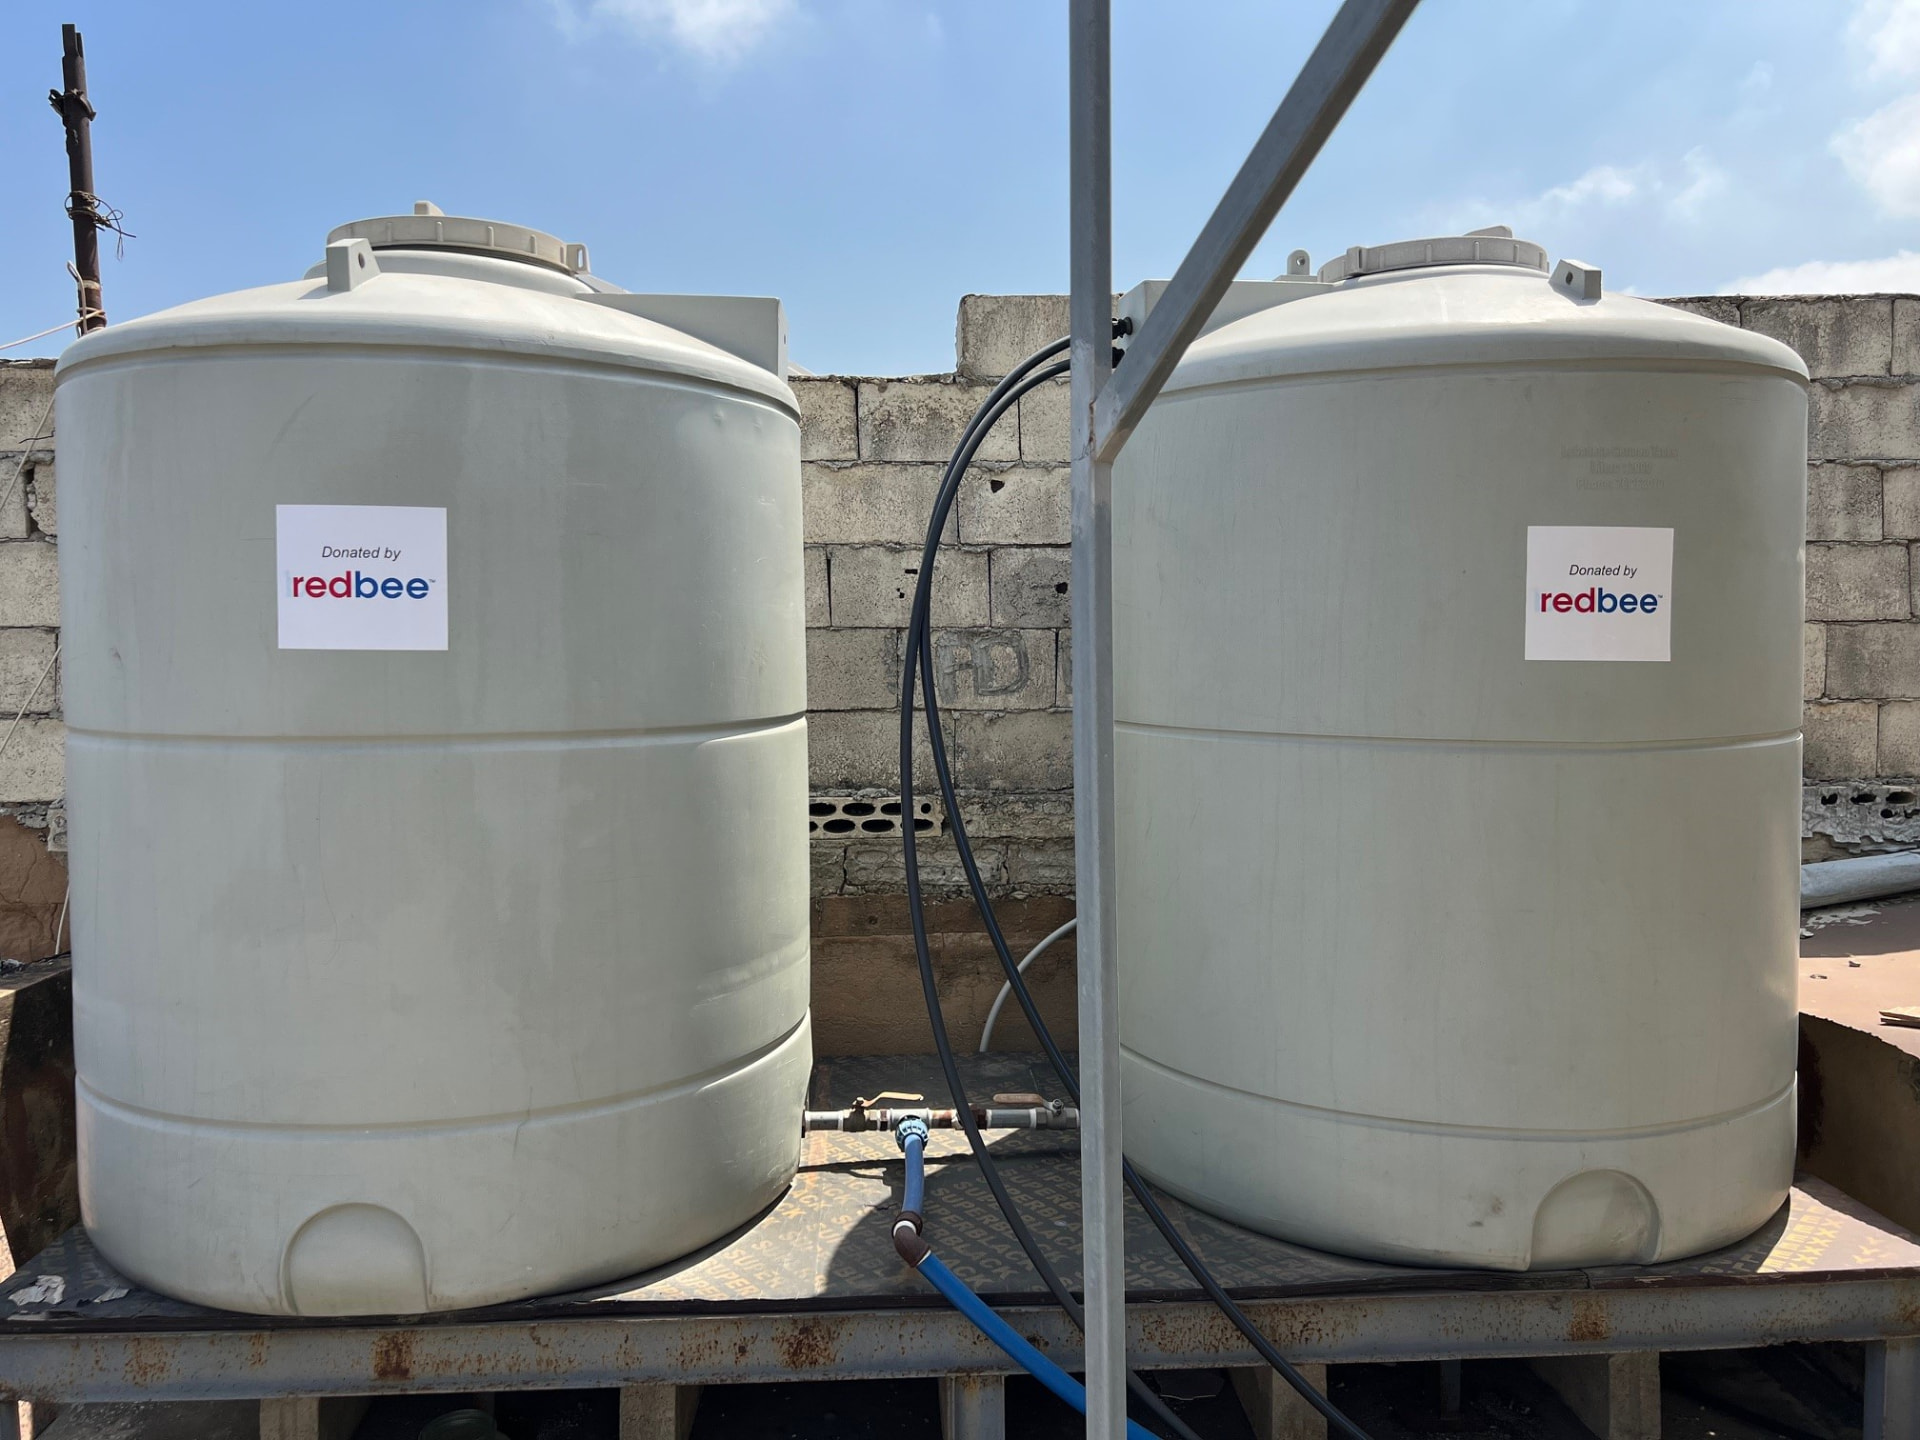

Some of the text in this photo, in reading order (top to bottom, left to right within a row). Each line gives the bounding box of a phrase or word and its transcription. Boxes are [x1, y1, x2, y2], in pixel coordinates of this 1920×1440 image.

[321, 546, 402, 562] Donated by
[1569, 564, 1638, 579] Donated by
